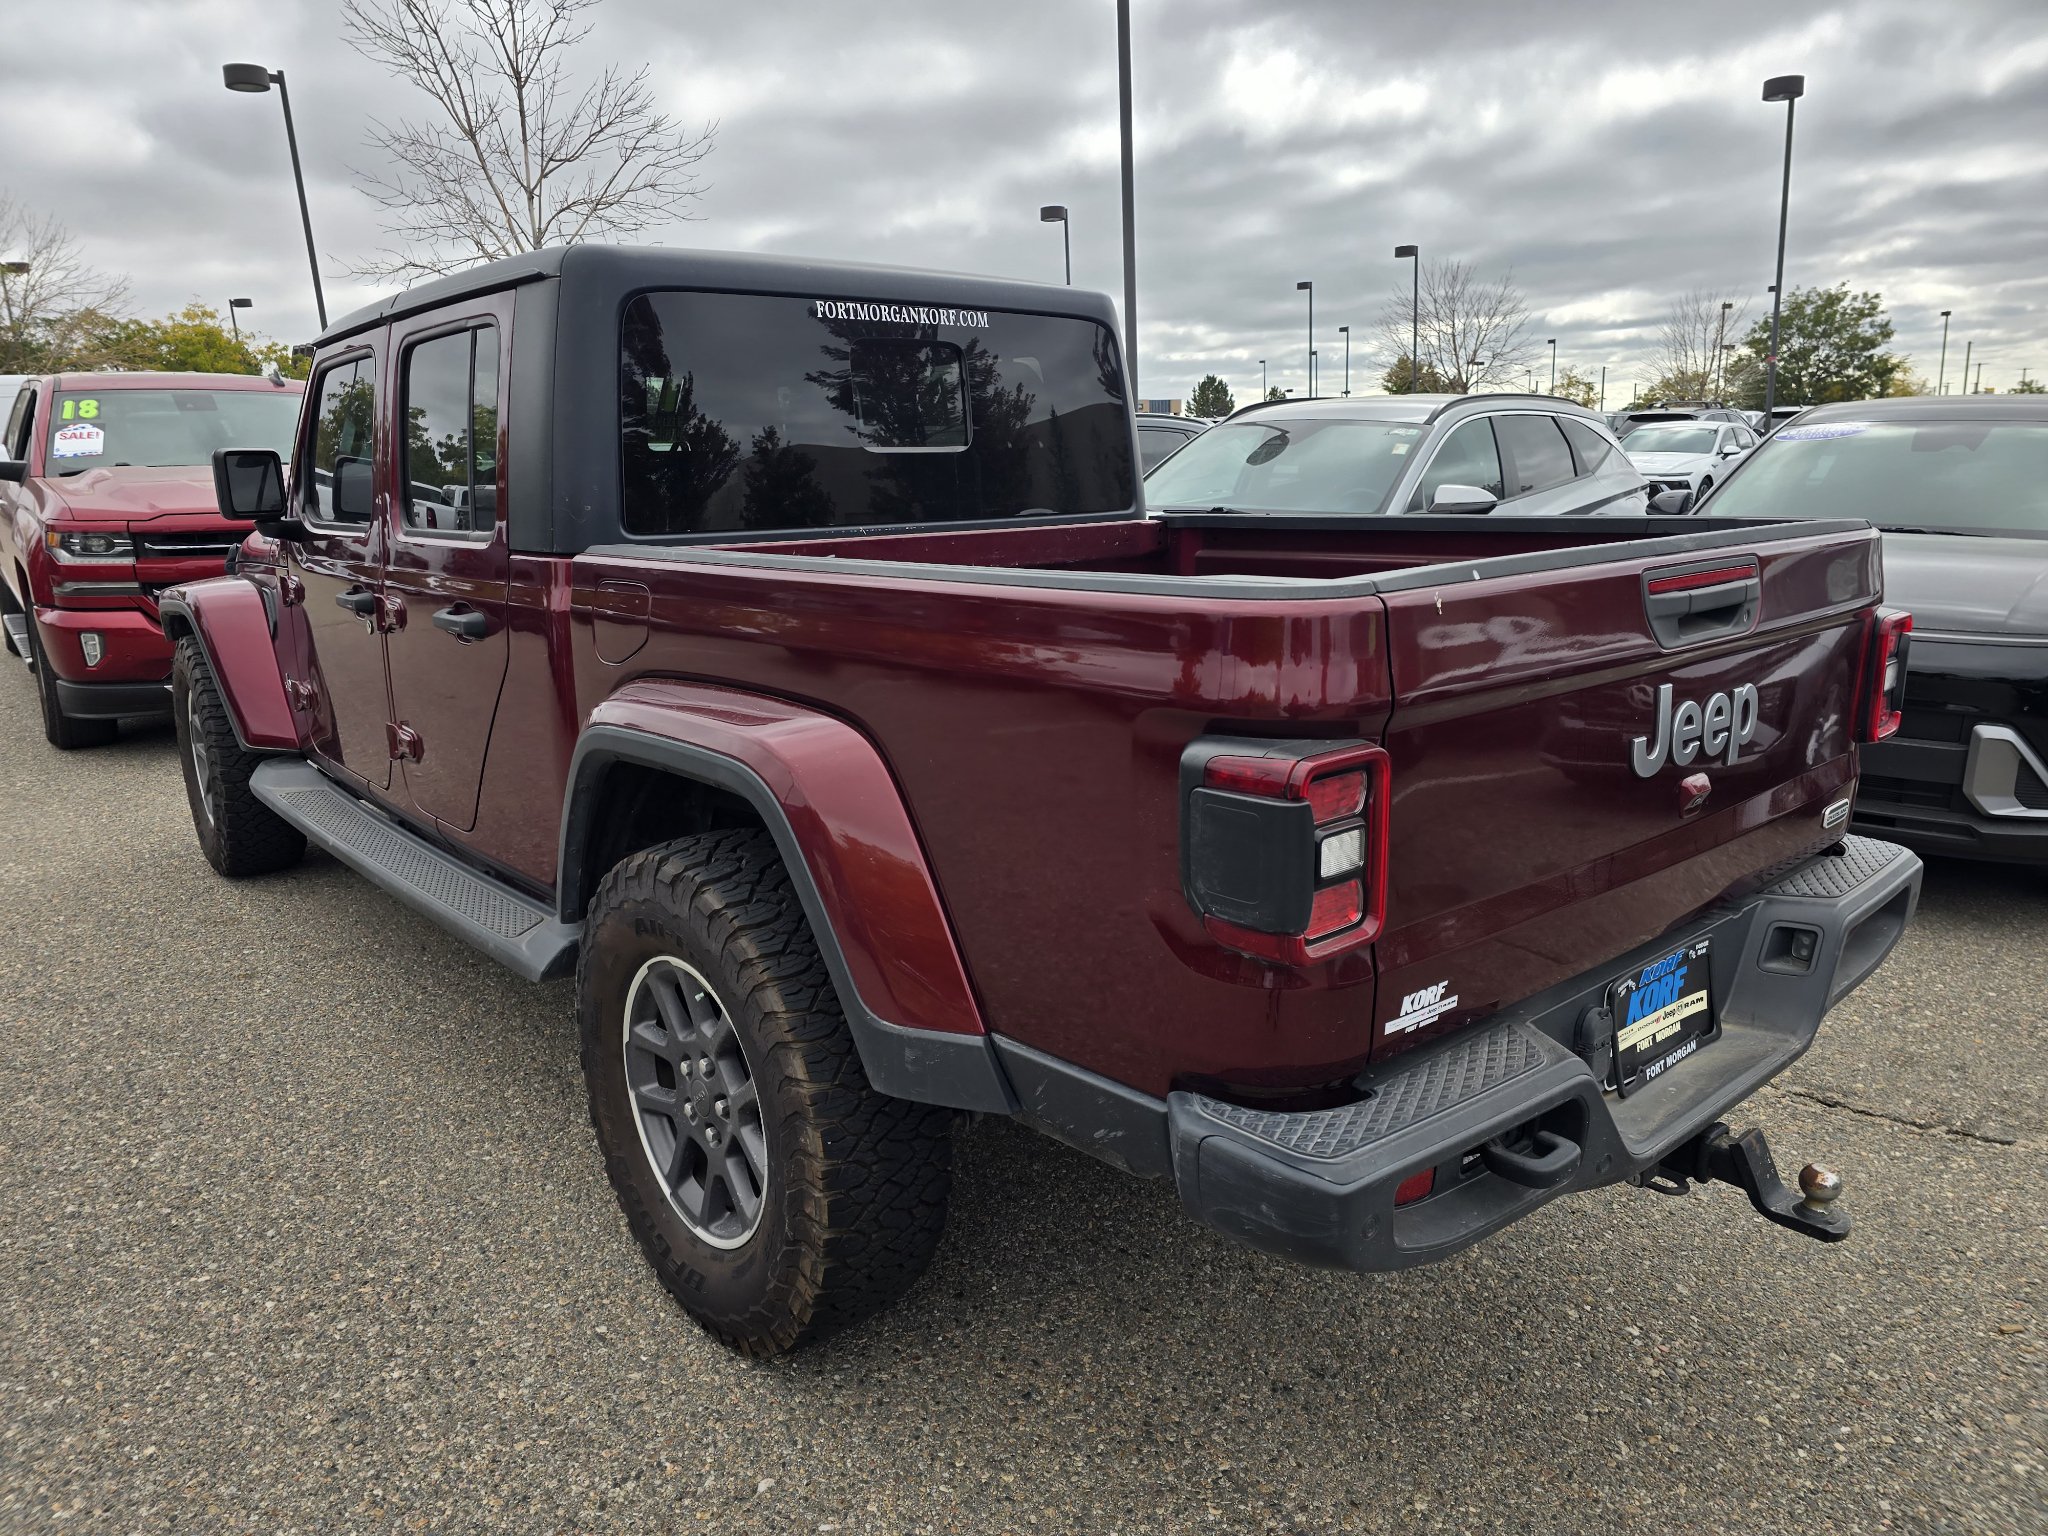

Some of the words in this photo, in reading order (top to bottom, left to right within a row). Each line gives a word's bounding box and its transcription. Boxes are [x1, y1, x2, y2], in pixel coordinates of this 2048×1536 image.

[815, 300, 990, 328] FORTMORGANKORF.COM
[62, 399, 99, 420] 18
[59, 431, 100, 441] SALE!
[1632, 682, 1759, 778] Jeep
[1639, 948, 1687, 988] KORF
[1400, 980, 1449, 1017] KORF
[1626, 965, 1688, 1027] KORF
[1684, 996, 1704, 1009] RAM
[1662, 1008, 1676, 1021] Jeep
[1637, 1034, 1654, 1053] FORT
[1655, 1020, 1682, 1043] MORGAN
[1646, 1060, 1665, 1081] FORT
[1666, 1039, 1697, 1068] MORGAN
